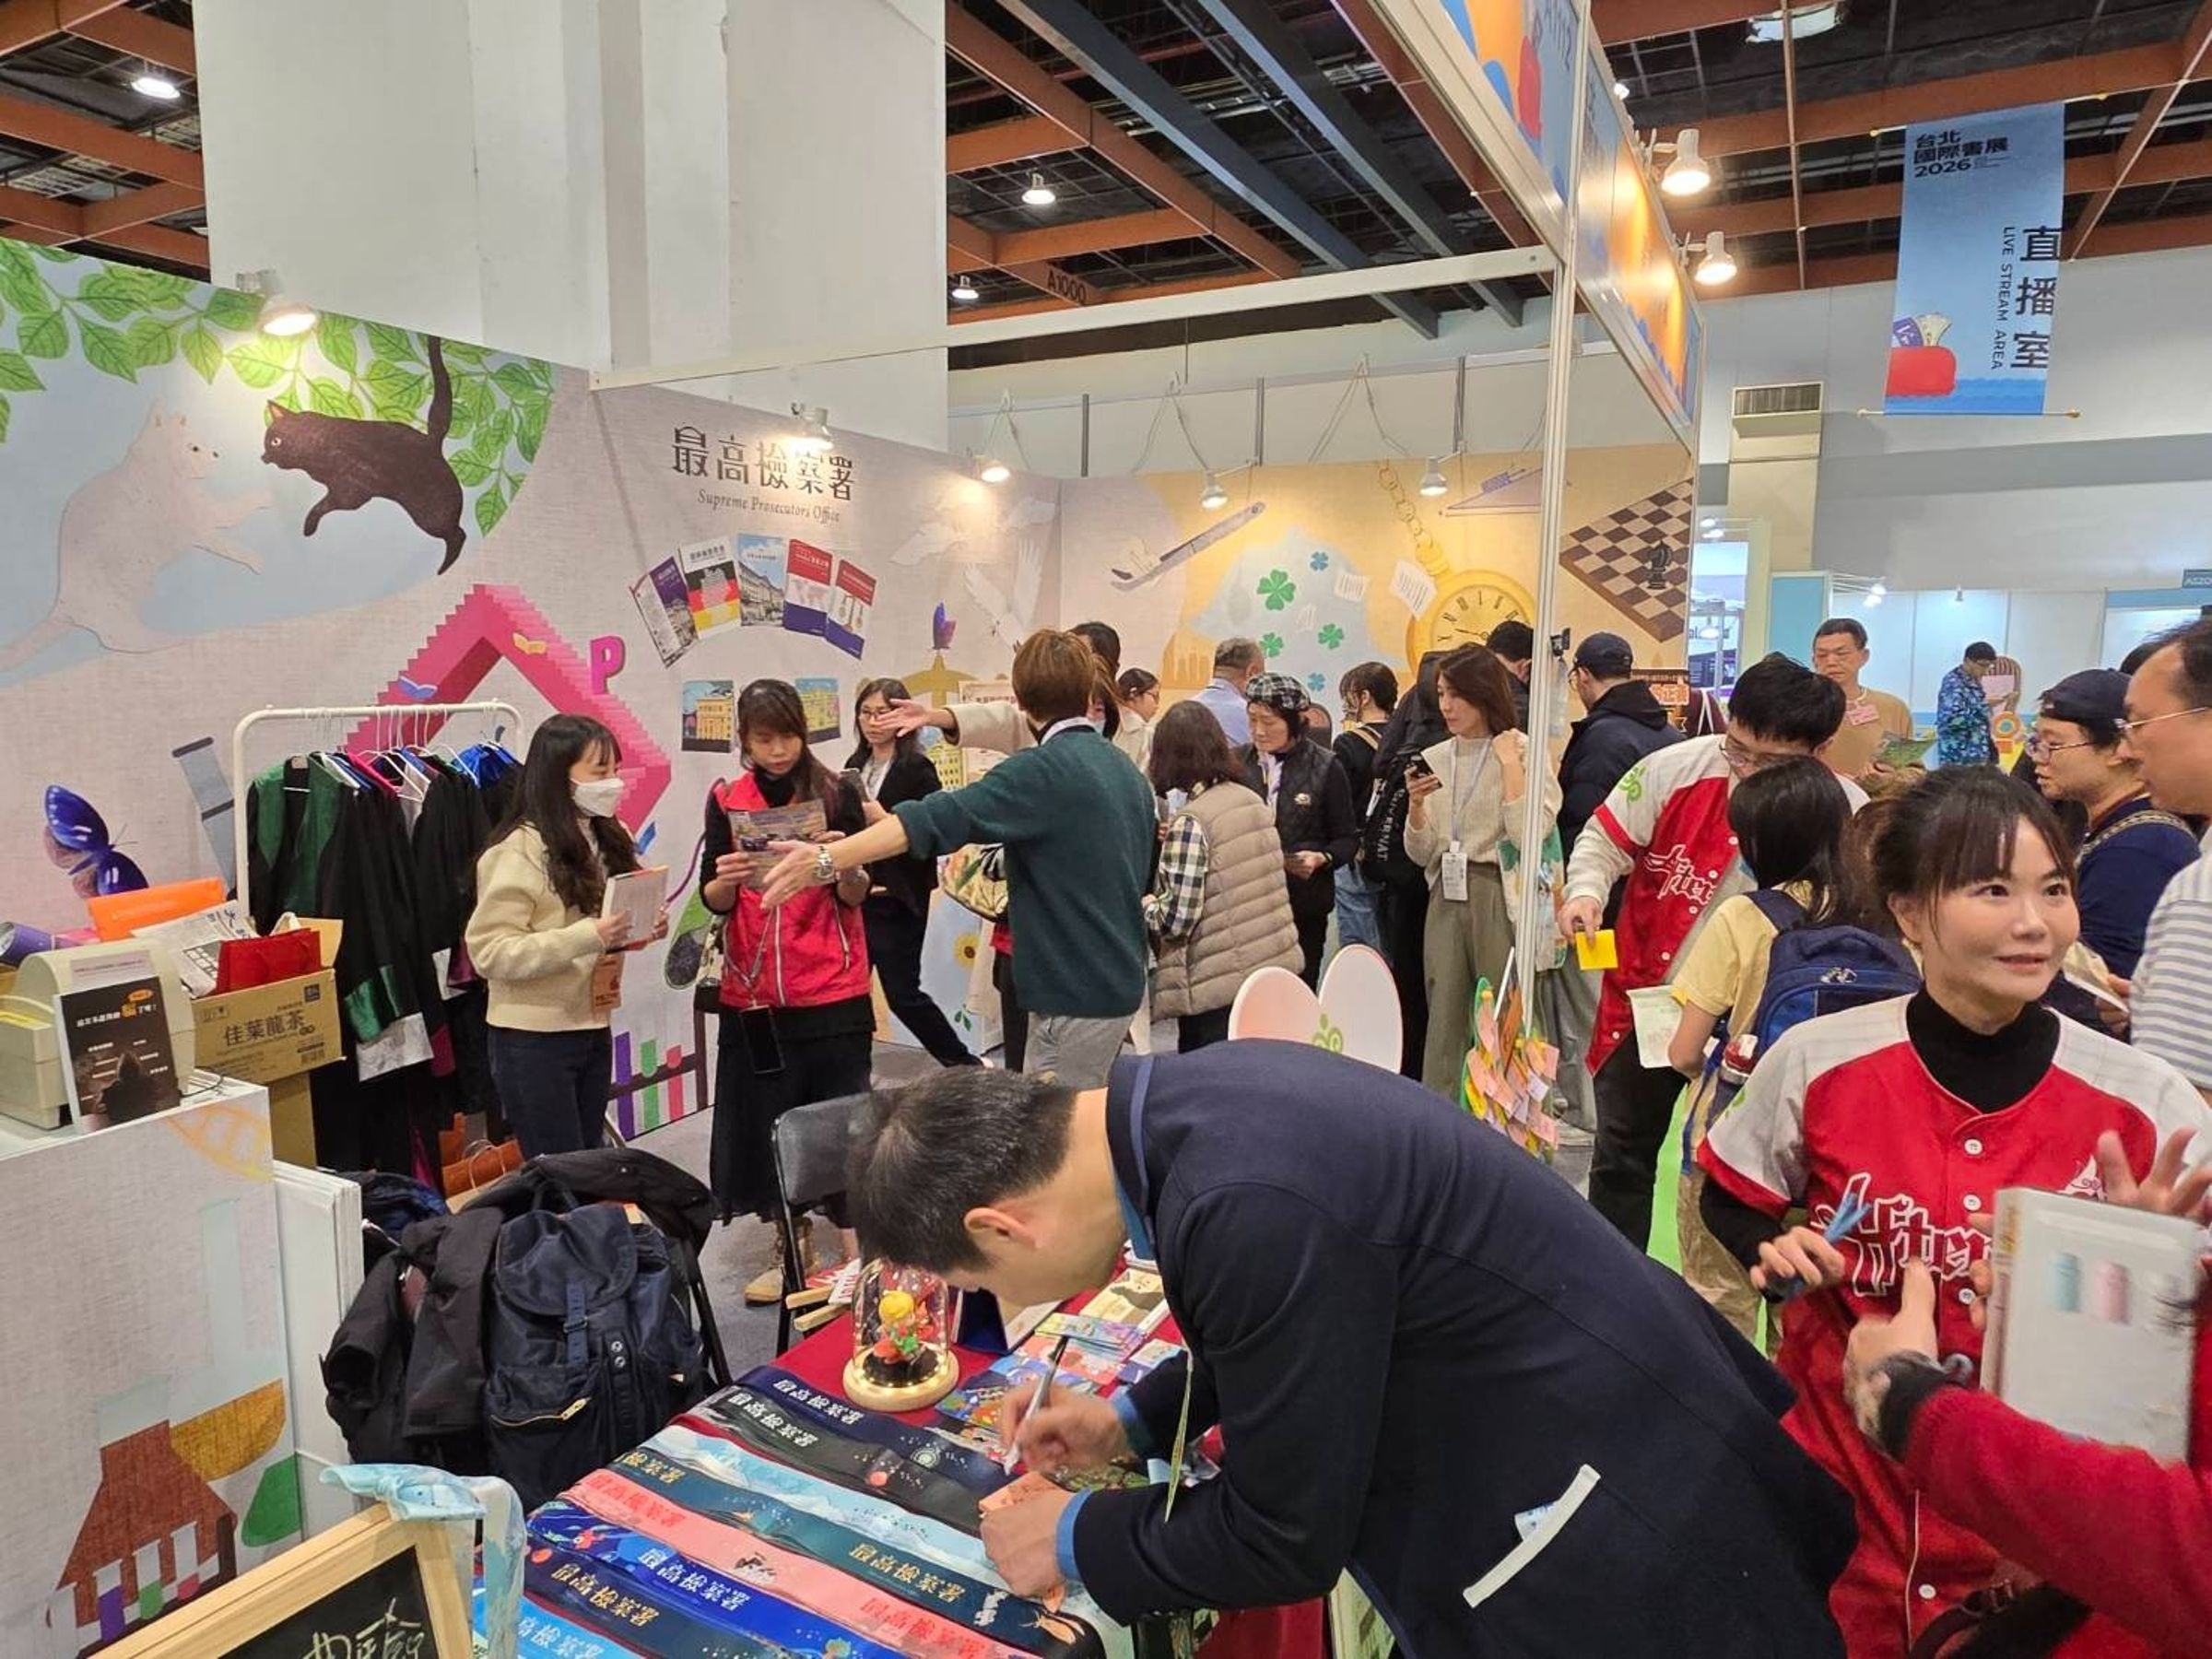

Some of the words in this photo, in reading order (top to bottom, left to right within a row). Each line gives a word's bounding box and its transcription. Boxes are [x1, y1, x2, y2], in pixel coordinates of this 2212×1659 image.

[1914, 137, 2008, 164] 國際書展
[1916, 130, 1960, 148] 台北
[1914, 159, 1971, 178] 2026
[2002, 226, 2016, 255] LIVE
[1047, 269, 1087, 305] A1000
[1997, 263, 2013, 322] STREAM
[2010, 225, 2063, 369] 直播室
[1991, 329, 2007, 370] AREA
[671, 425, 854, 500] 最高檢察署
[698, 488, 747, 511] Supreme
[751, 496, 811, 518] Prosecutors
[590, 634, 626, 696] P
[727, 1393, 819, 1447] 最高檢察署
[772, 1379, 865, 1425] 最高檢察署
[550, 1563, 660, 1628] 最高檢察署
[638, 1548, 751, 1611] 最高檢察署
[849, 1543, 966, 1604] 最高檢察署
